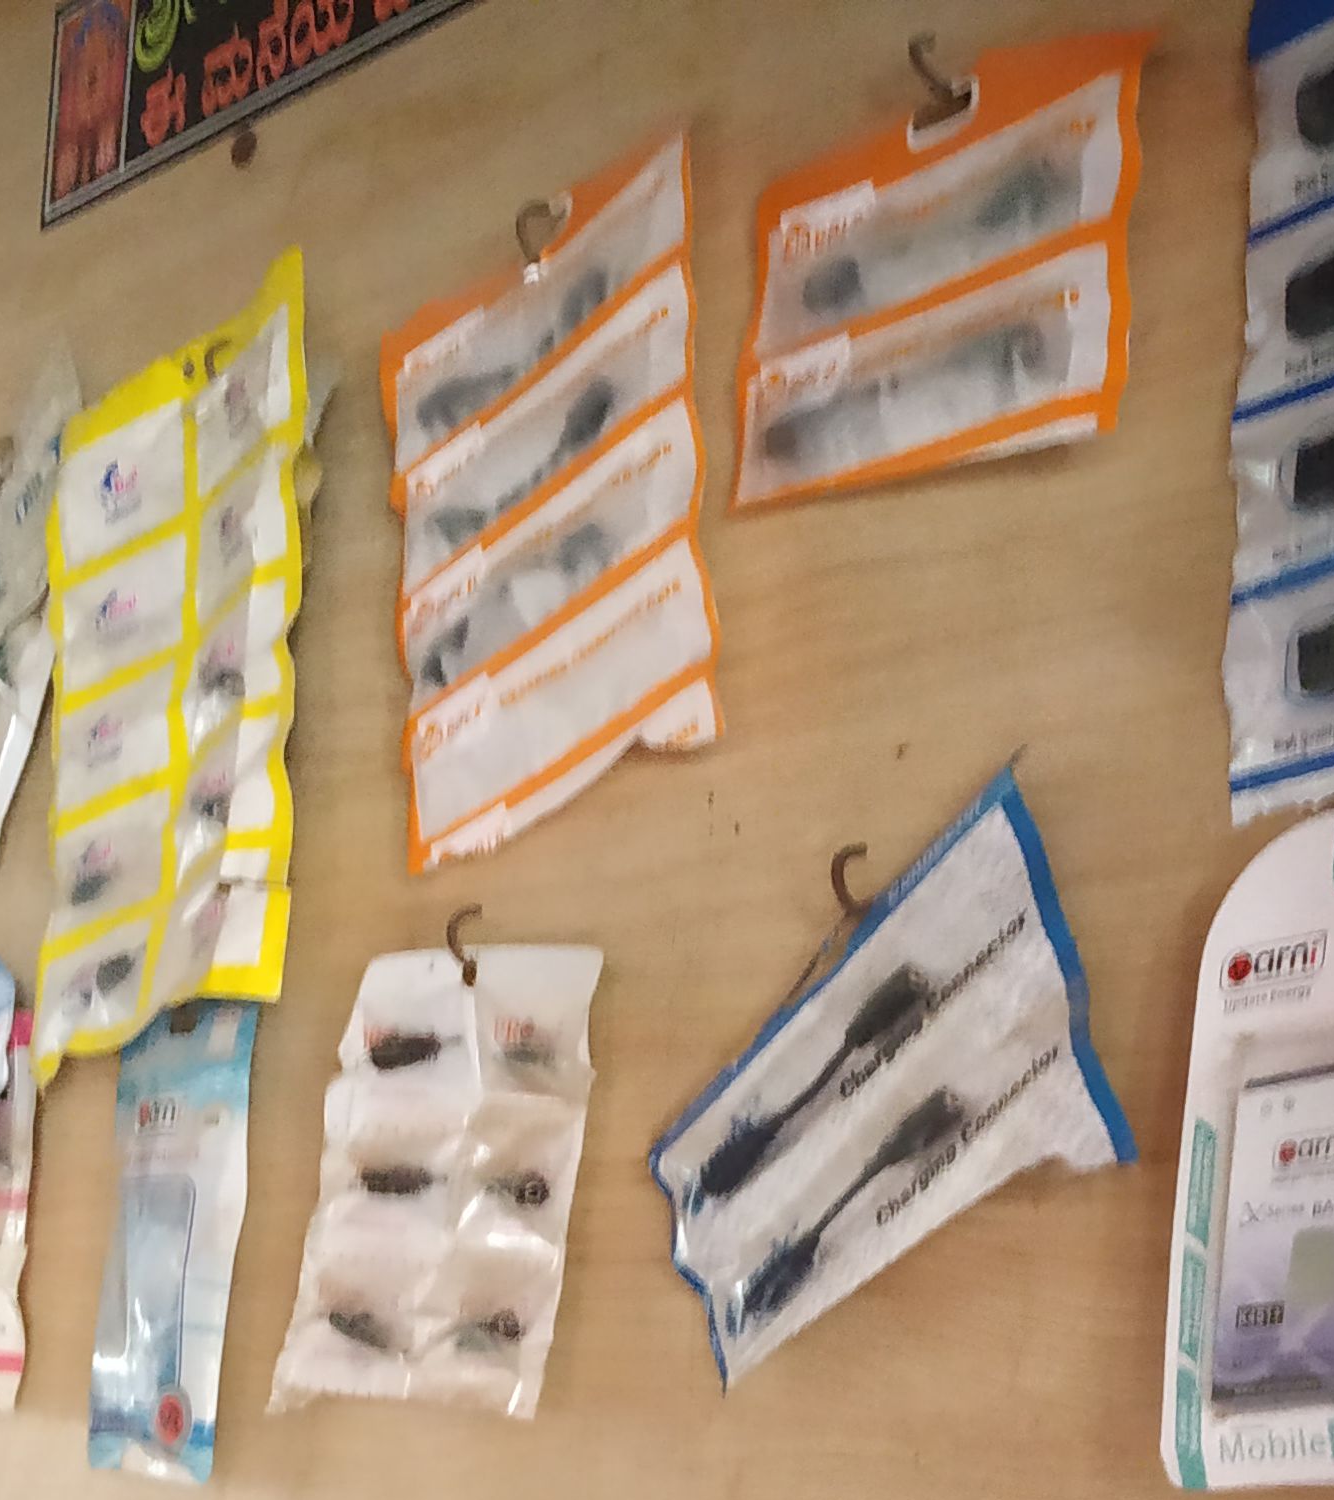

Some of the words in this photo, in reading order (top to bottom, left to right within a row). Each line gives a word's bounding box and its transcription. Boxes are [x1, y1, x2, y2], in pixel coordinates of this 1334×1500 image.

[877, 1144, 957, 1228] Charging
[960, 1045, 1060, 1142] Connector
[1219, 1427, 1327, 1465] Mobile
